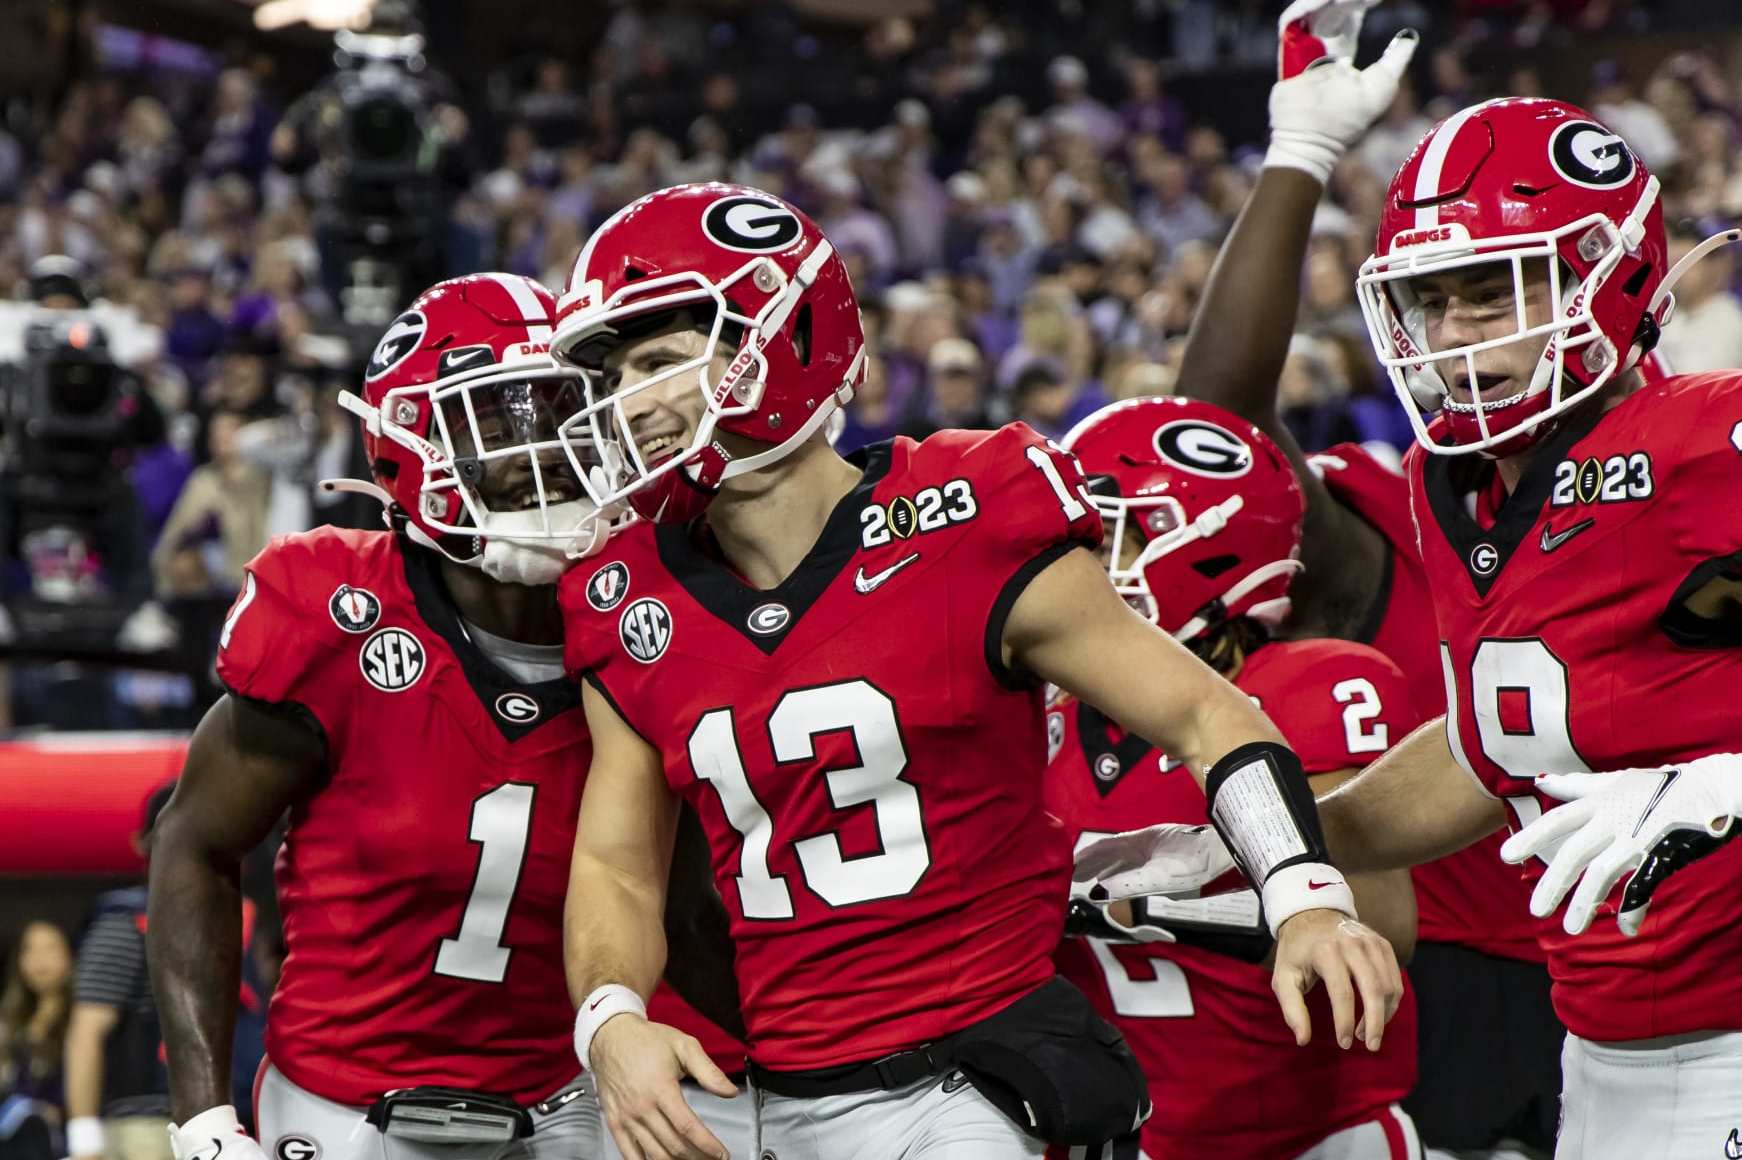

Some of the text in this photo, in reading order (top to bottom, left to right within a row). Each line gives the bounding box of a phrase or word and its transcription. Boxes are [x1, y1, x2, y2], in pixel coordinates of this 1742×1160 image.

[704, 196, 802, 252] G
[1395, 227, 1452, 248] DAWGS
[1154, 421, 1251, 476] G
[364, 631, 421, 688] SEC
[623, 602, 669, 660] SEC
[1331, 677, 1389, 754] 2
[686, 676, 933, 922] 13
[432, 781, 537, 984] 1
